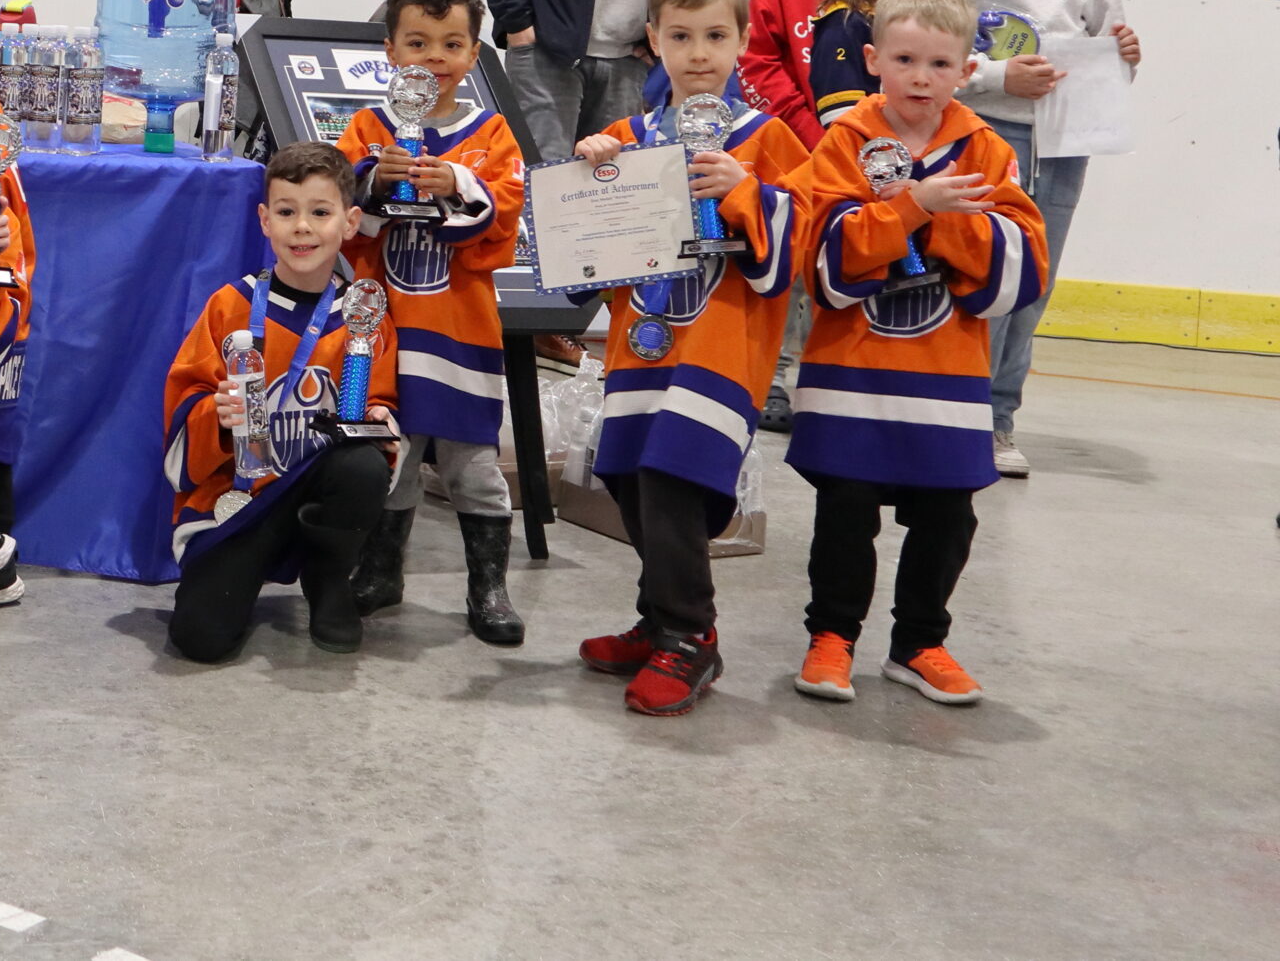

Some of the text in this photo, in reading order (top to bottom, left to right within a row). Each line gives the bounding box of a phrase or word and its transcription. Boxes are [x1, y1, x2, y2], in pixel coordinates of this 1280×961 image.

[836, 47, 847, 61] 2
[597, 168, 616, 178] Esso
[560, 181, 659, 203] Certificate of Achievement
